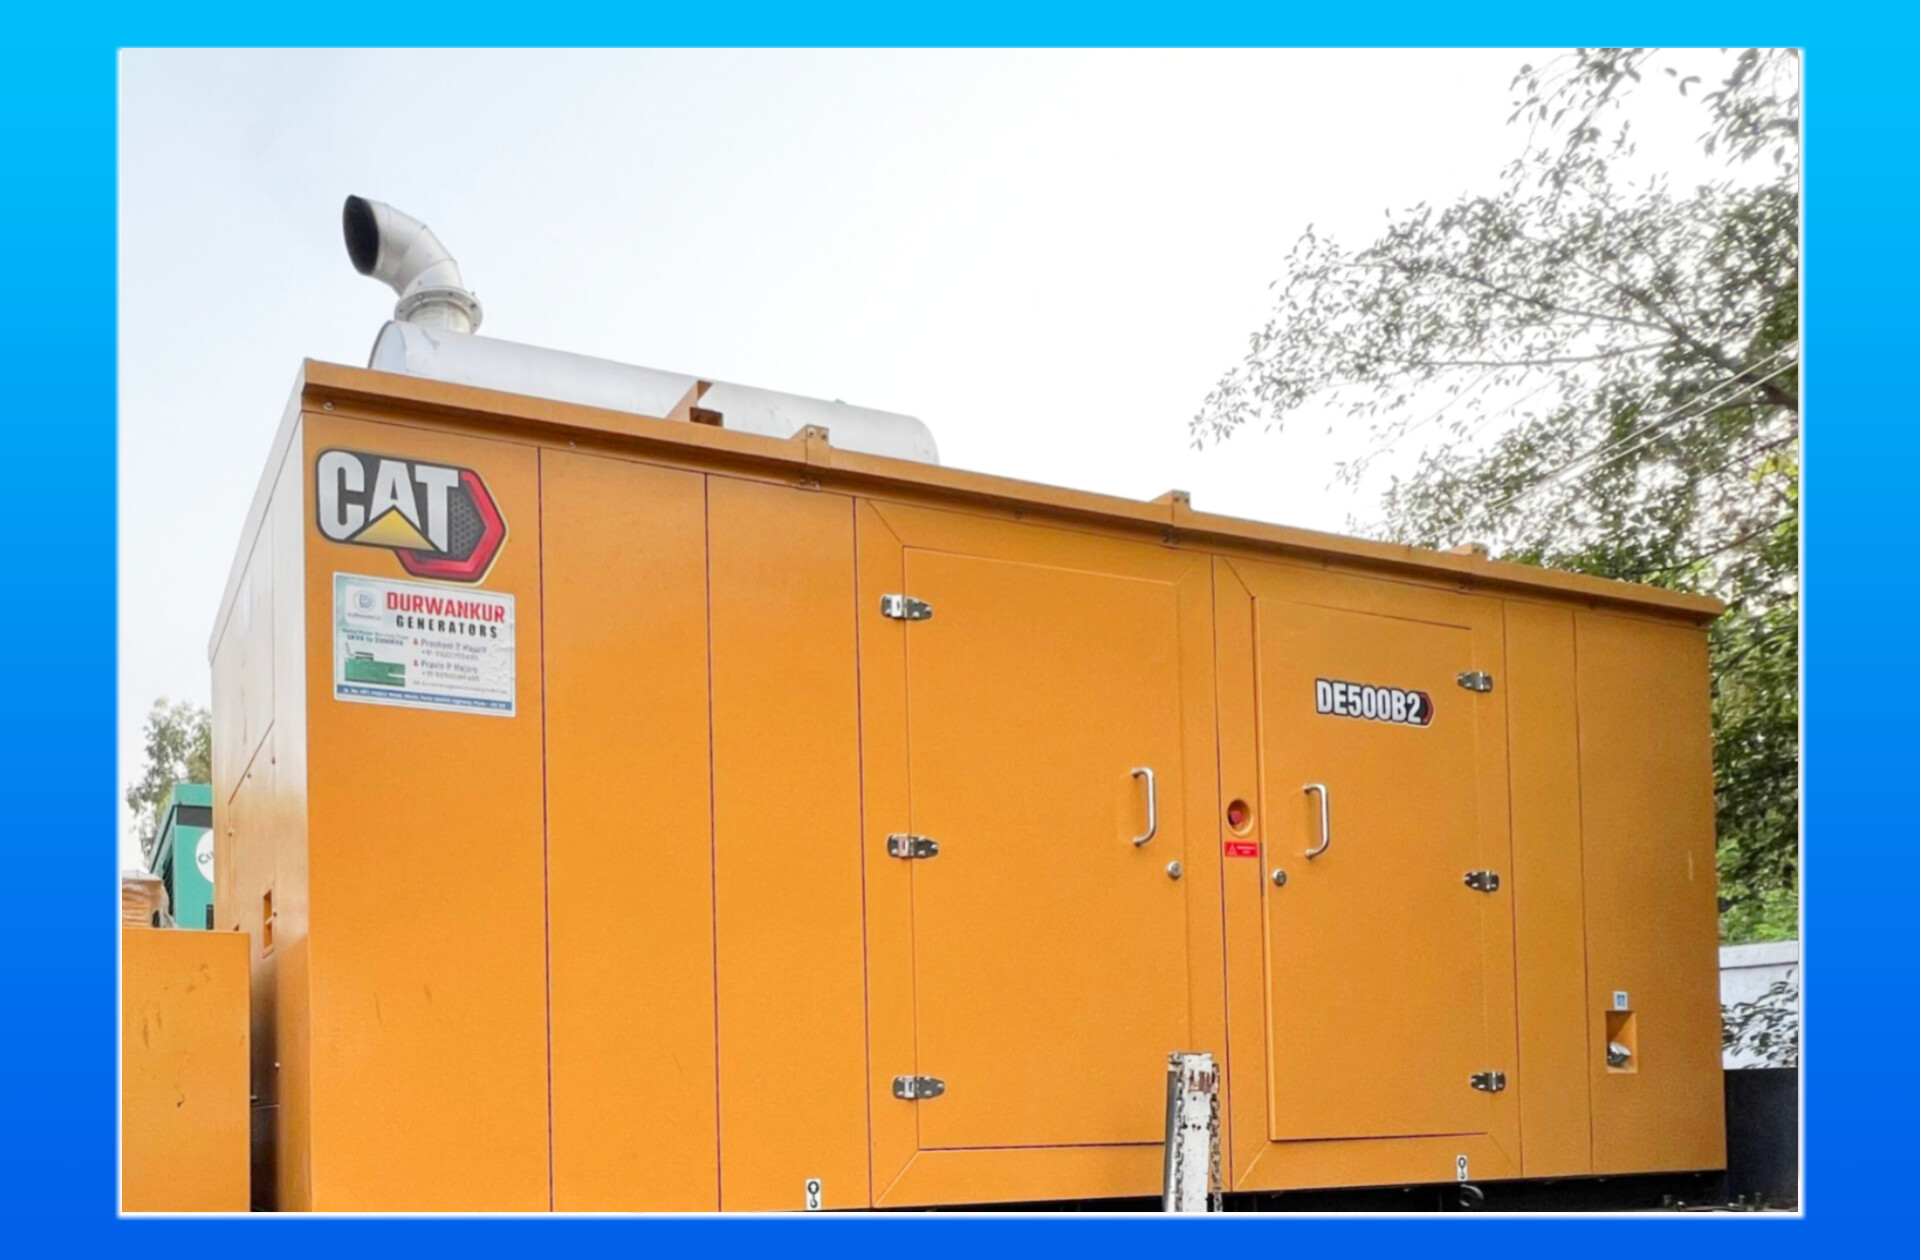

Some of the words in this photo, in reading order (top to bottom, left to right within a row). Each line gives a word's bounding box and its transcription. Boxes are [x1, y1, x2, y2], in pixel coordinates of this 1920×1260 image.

[318, 450, 459, 553] CAT
[386, 591, 506, 624] DURWANKUR
[396, 614, 498, 639] GENERATORS
[1316, 679, 1422, 724] DE500B2
